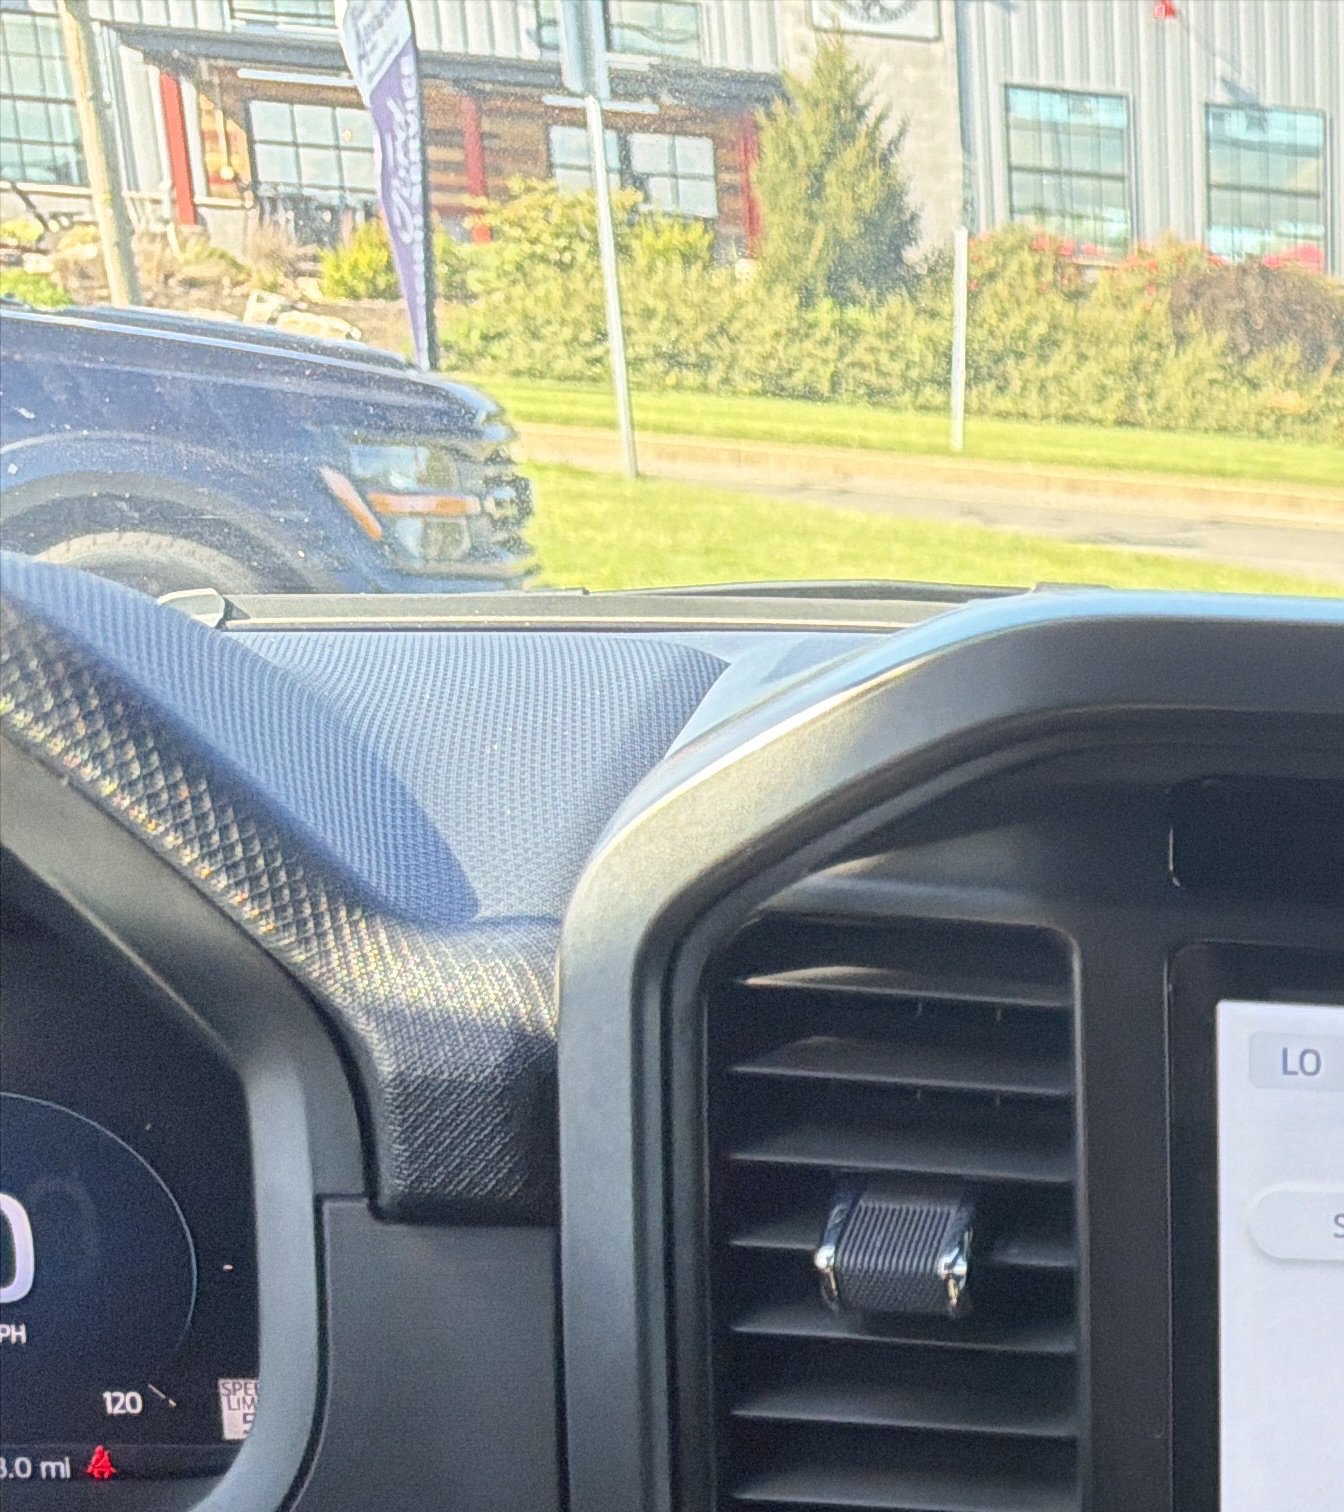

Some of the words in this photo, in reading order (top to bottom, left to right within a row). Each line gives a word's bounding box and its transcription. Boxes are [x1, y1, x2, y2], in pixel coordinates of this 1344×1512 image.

[1280, 1046, 1322, 1078] LO
[102, 1390, 143, 1414] 120
[39, 1456, 70, 1478] mi
